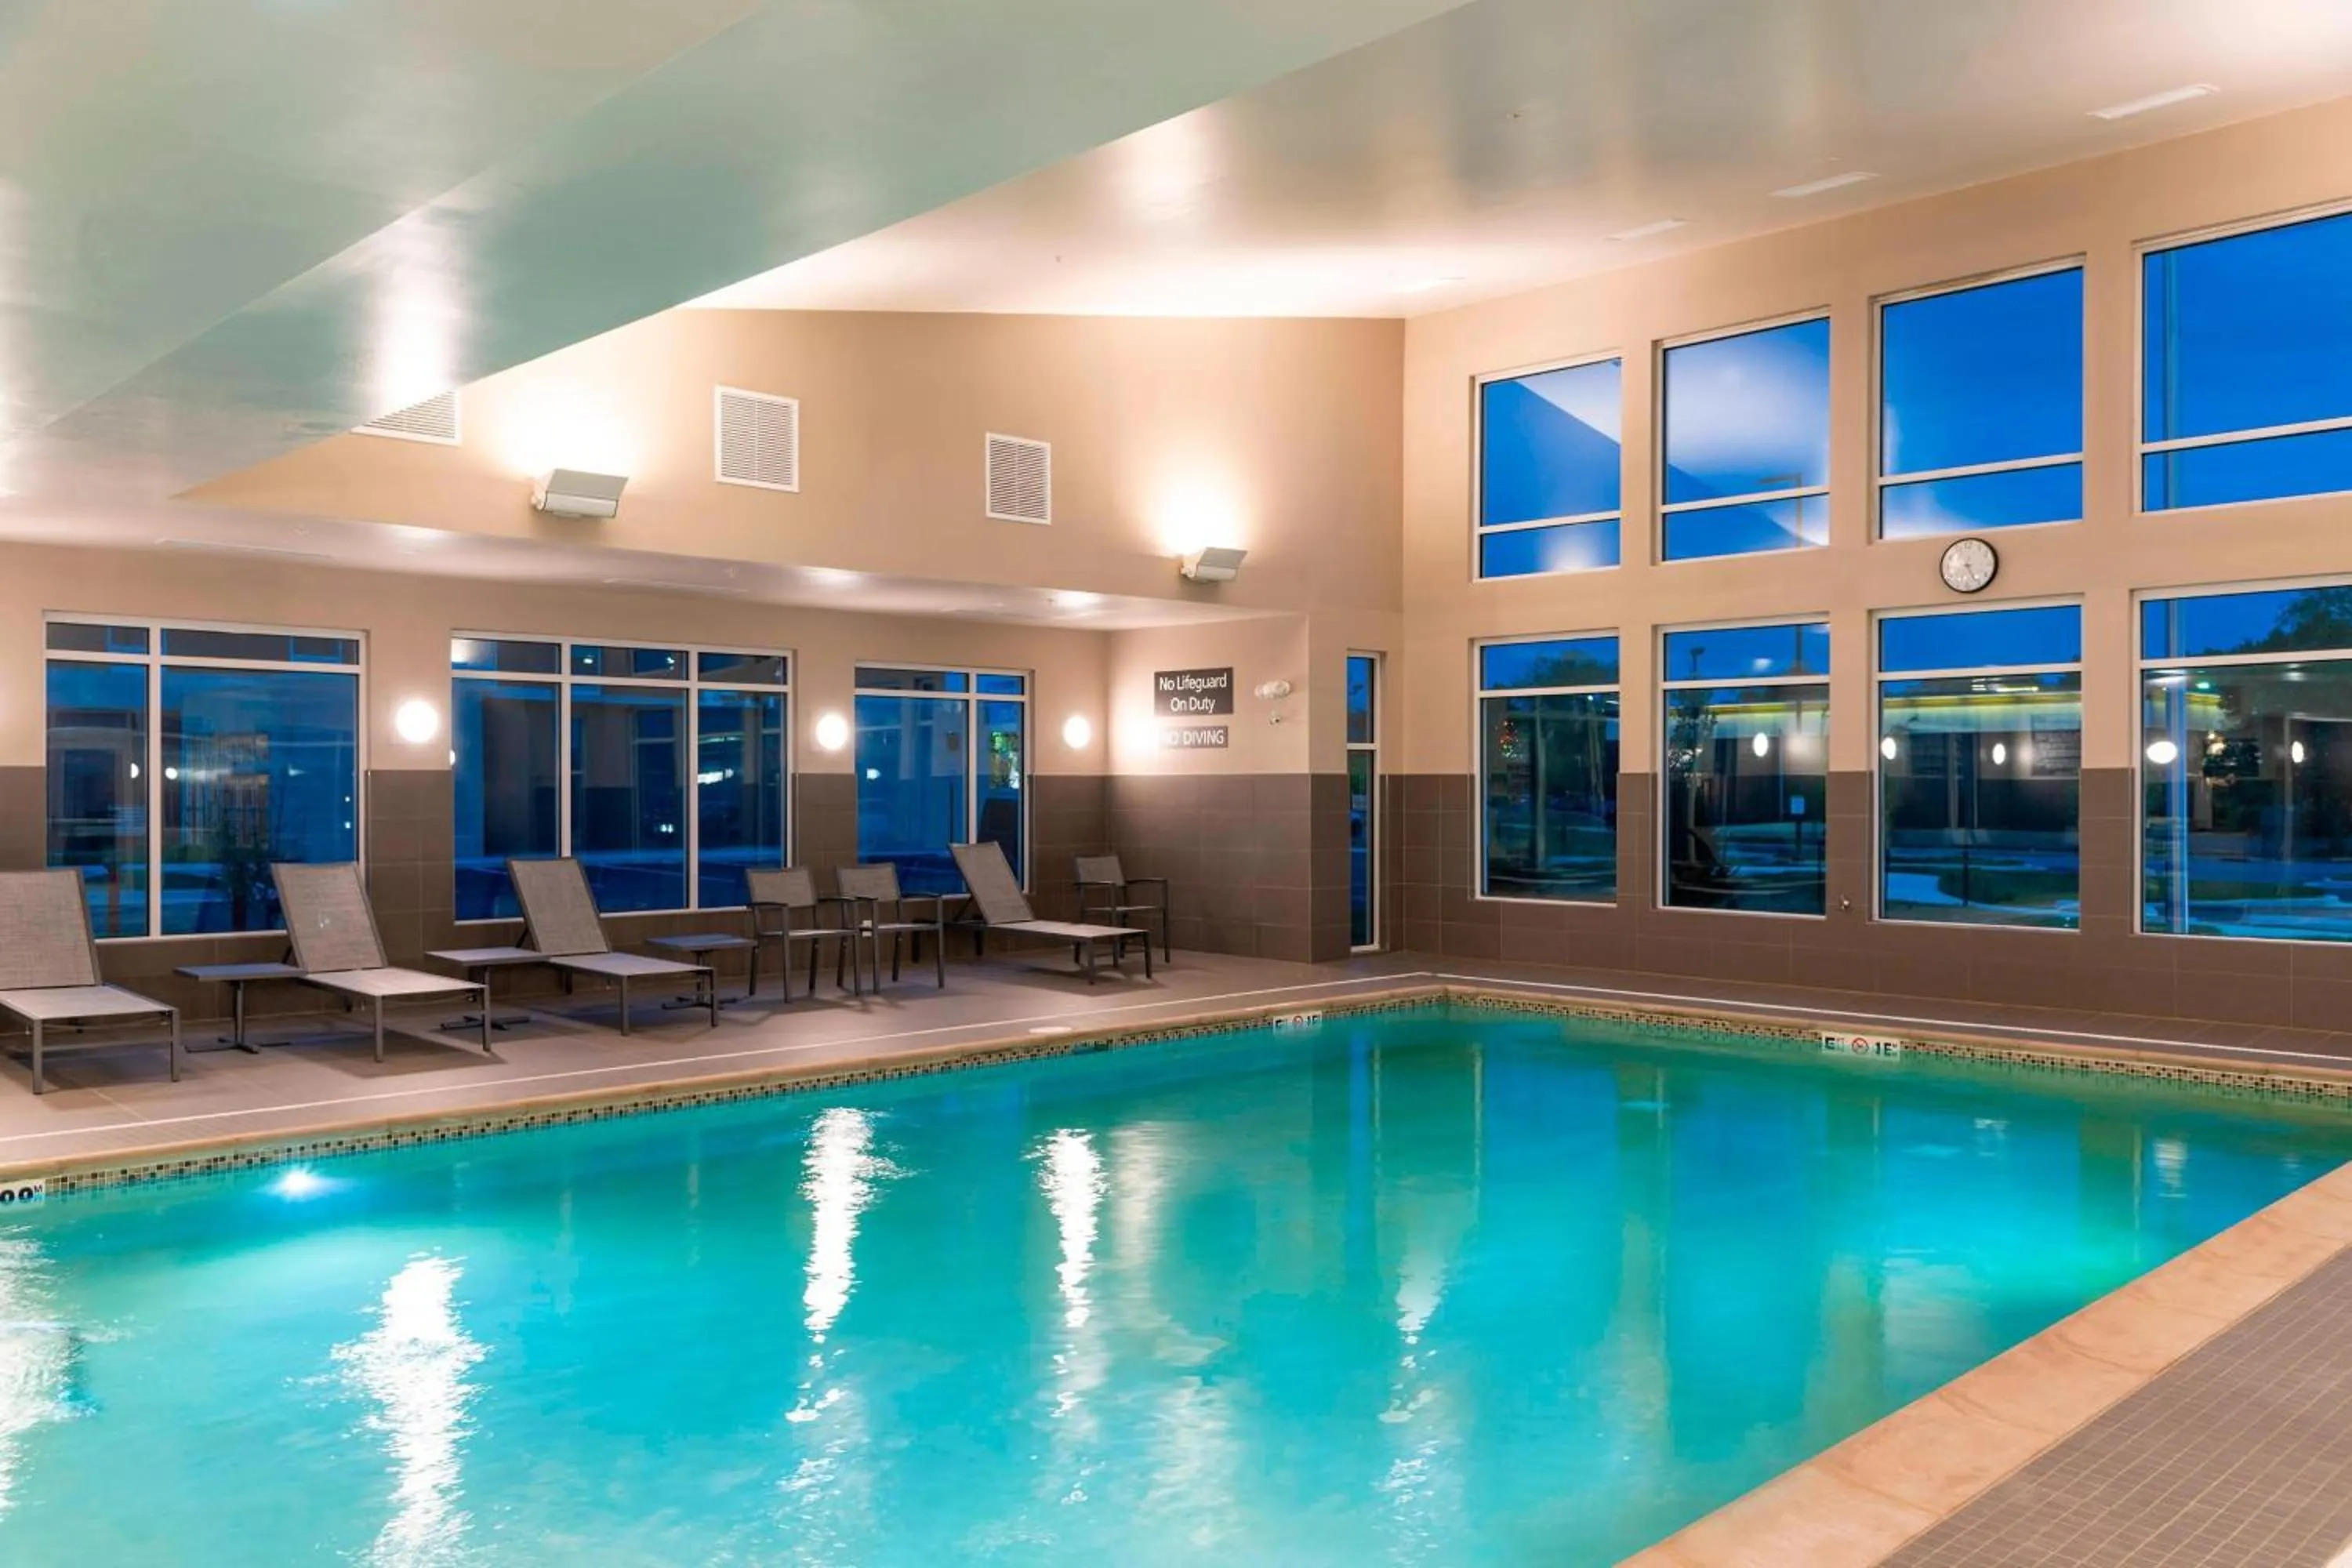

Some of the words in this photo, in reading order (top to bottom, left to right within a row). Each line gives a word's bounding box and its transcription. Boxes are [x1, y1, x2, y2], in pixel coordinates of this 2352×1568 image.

[1160, 677, 1174, 691] No
[1177, 673, 1227, 692] Lifeguard
[1171, 697, 1187, 711] On
[1189, 696, 1216, 713] Duty
[1183, 729, 1224, 745] DIVING
